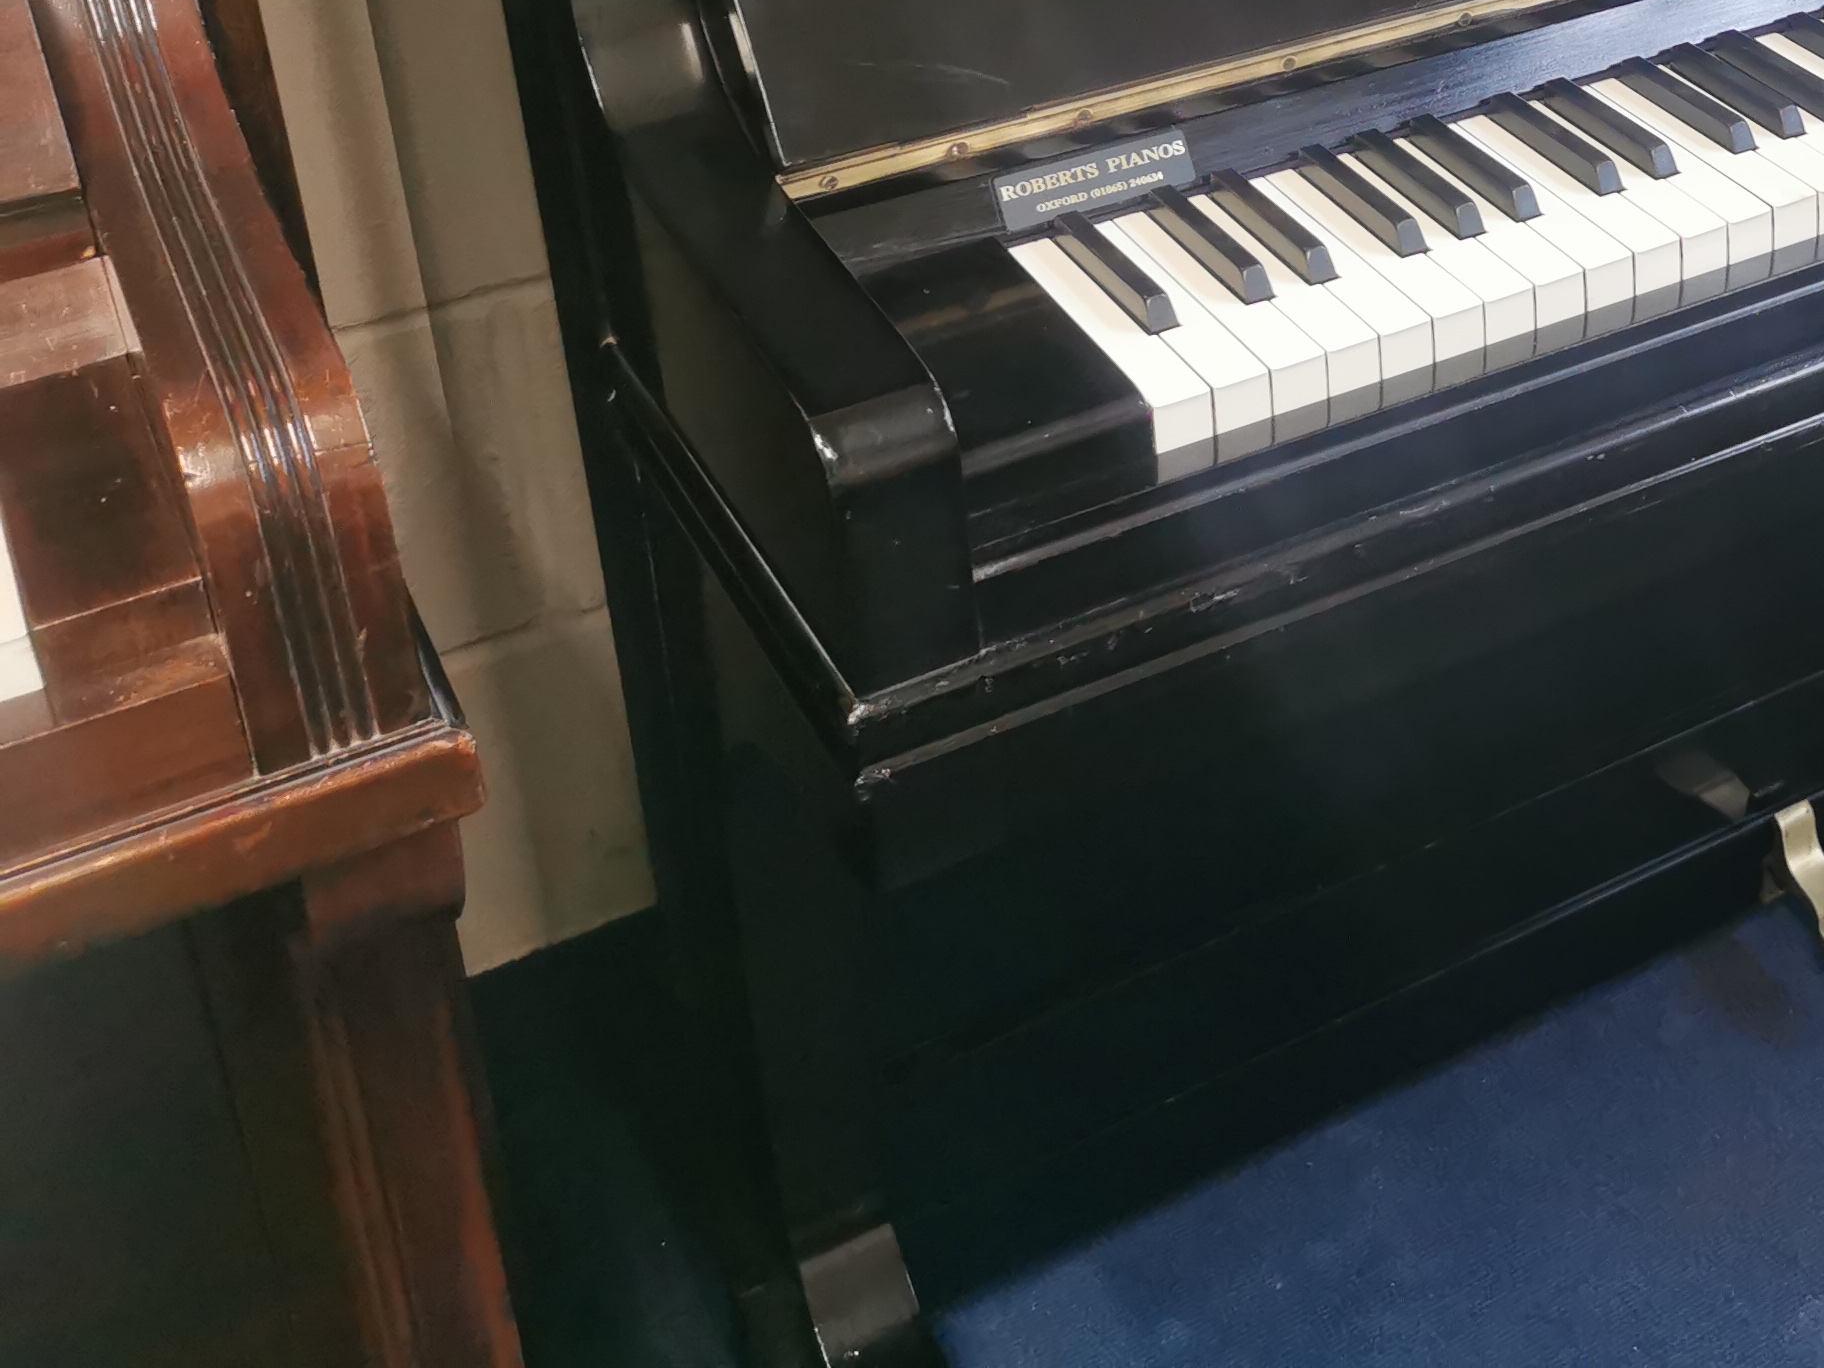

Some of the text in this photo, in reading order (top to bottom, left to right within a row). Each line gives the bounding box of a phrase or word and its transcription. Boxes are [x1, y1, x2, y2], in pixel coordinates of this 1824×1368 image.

[1000, 140, 1186, 201] ROBERTS PIANOS
[1036, 192, 1088, 213] OXFORD
[1090, 181, 1128, 200] (01865)
